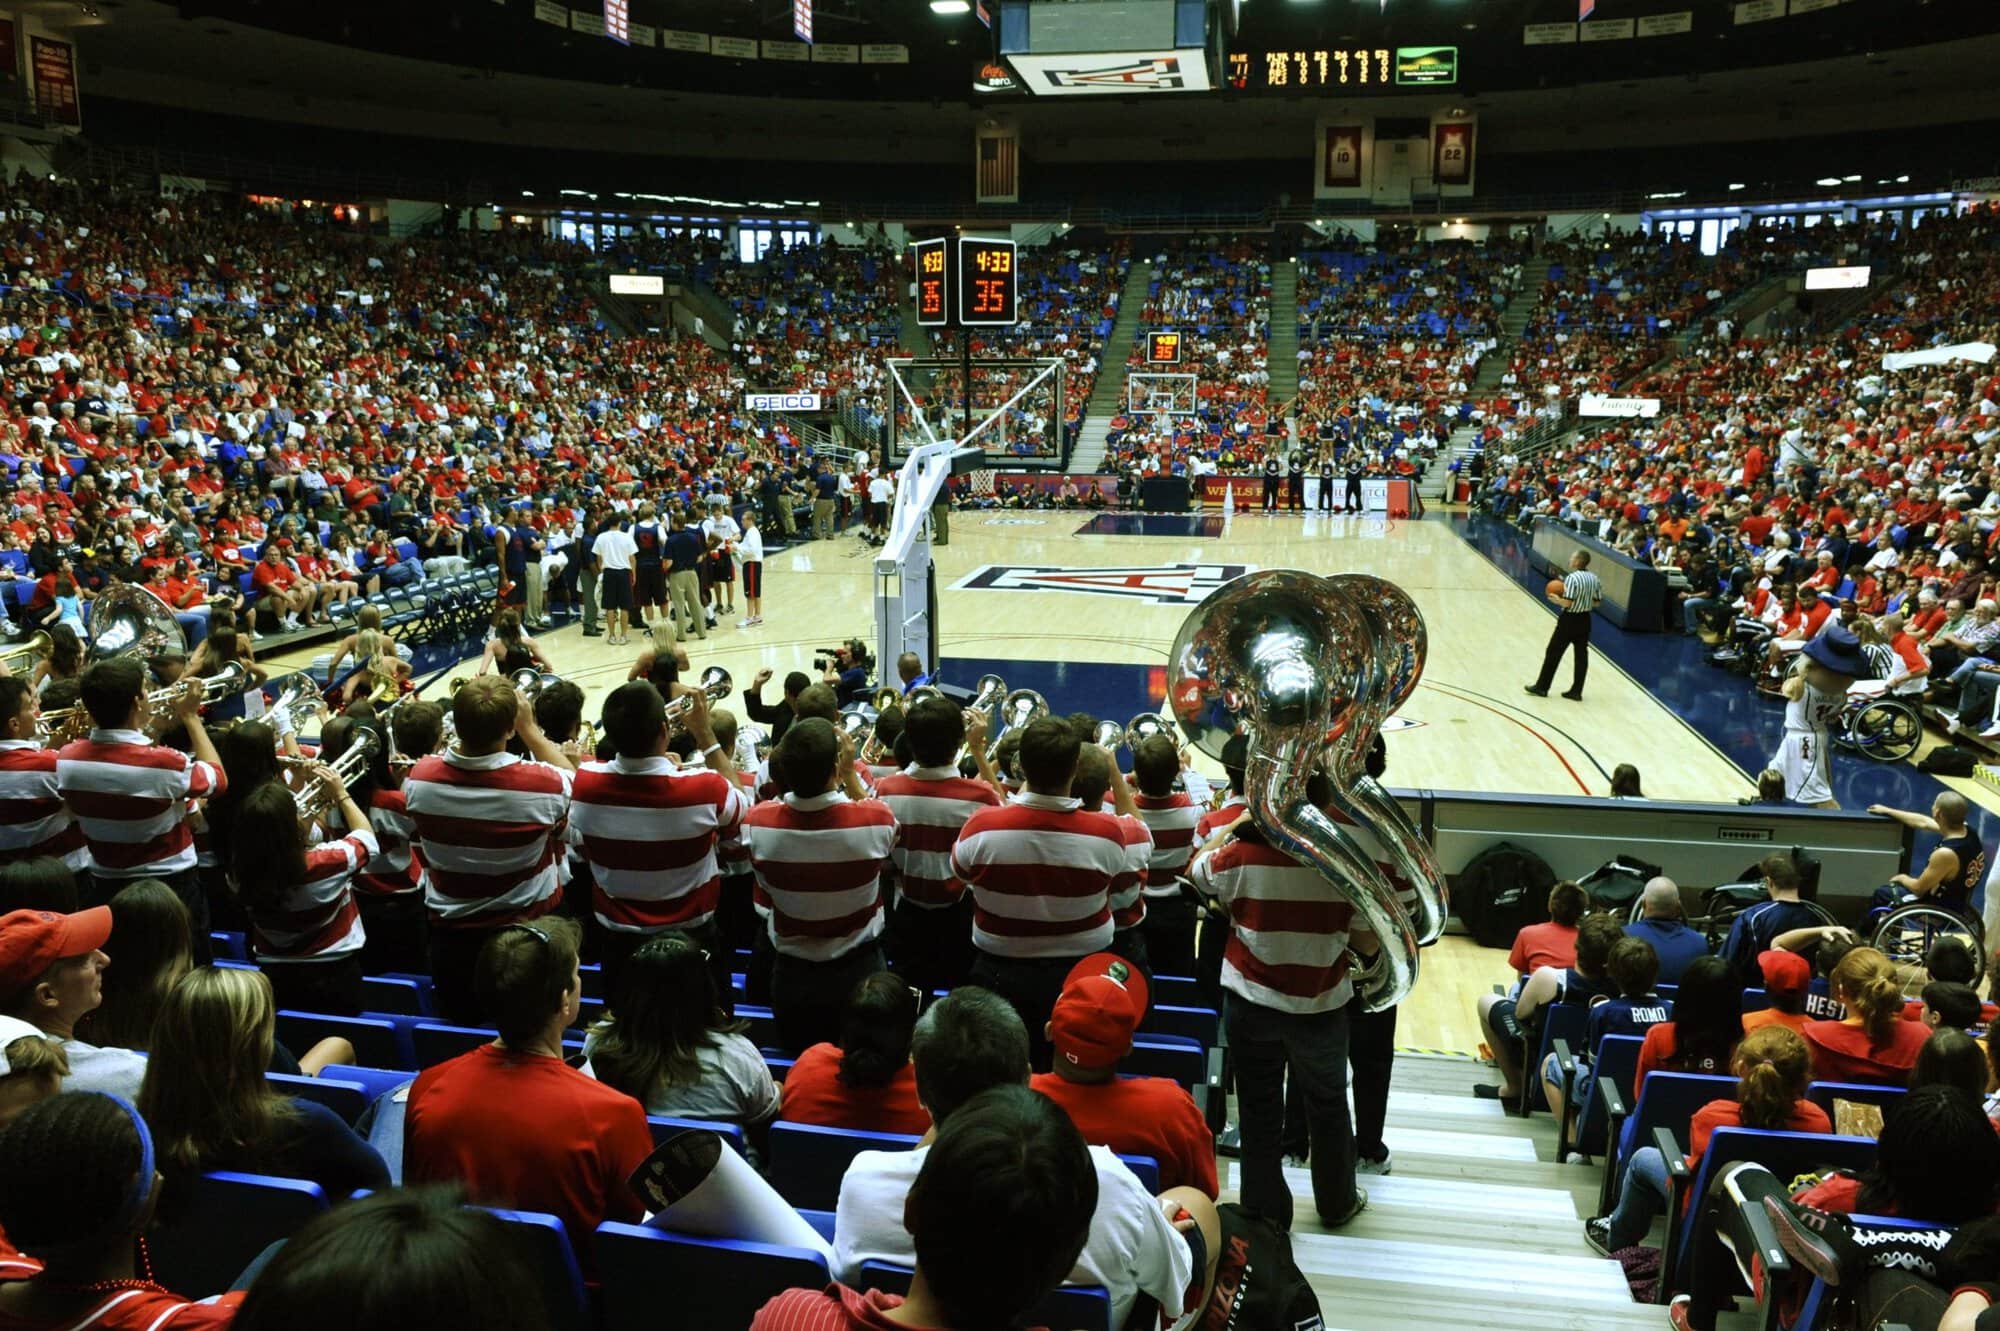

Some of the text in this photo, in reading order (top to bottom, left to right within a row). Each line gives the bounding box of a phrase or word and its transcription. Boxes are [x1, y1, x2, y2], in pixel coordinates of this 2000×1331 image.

[1337, 151, 1350, 163] 10
[1444, 149, 1461, 161] 22
[977, 251, 1011, 273] 4:33
[974, 280, 1004, 312] 35
[1154, 346, 1173, 359] 35
[753, 396, 814, 409] GEICO
[1631, 1007, 1668, 1023] ROMO
